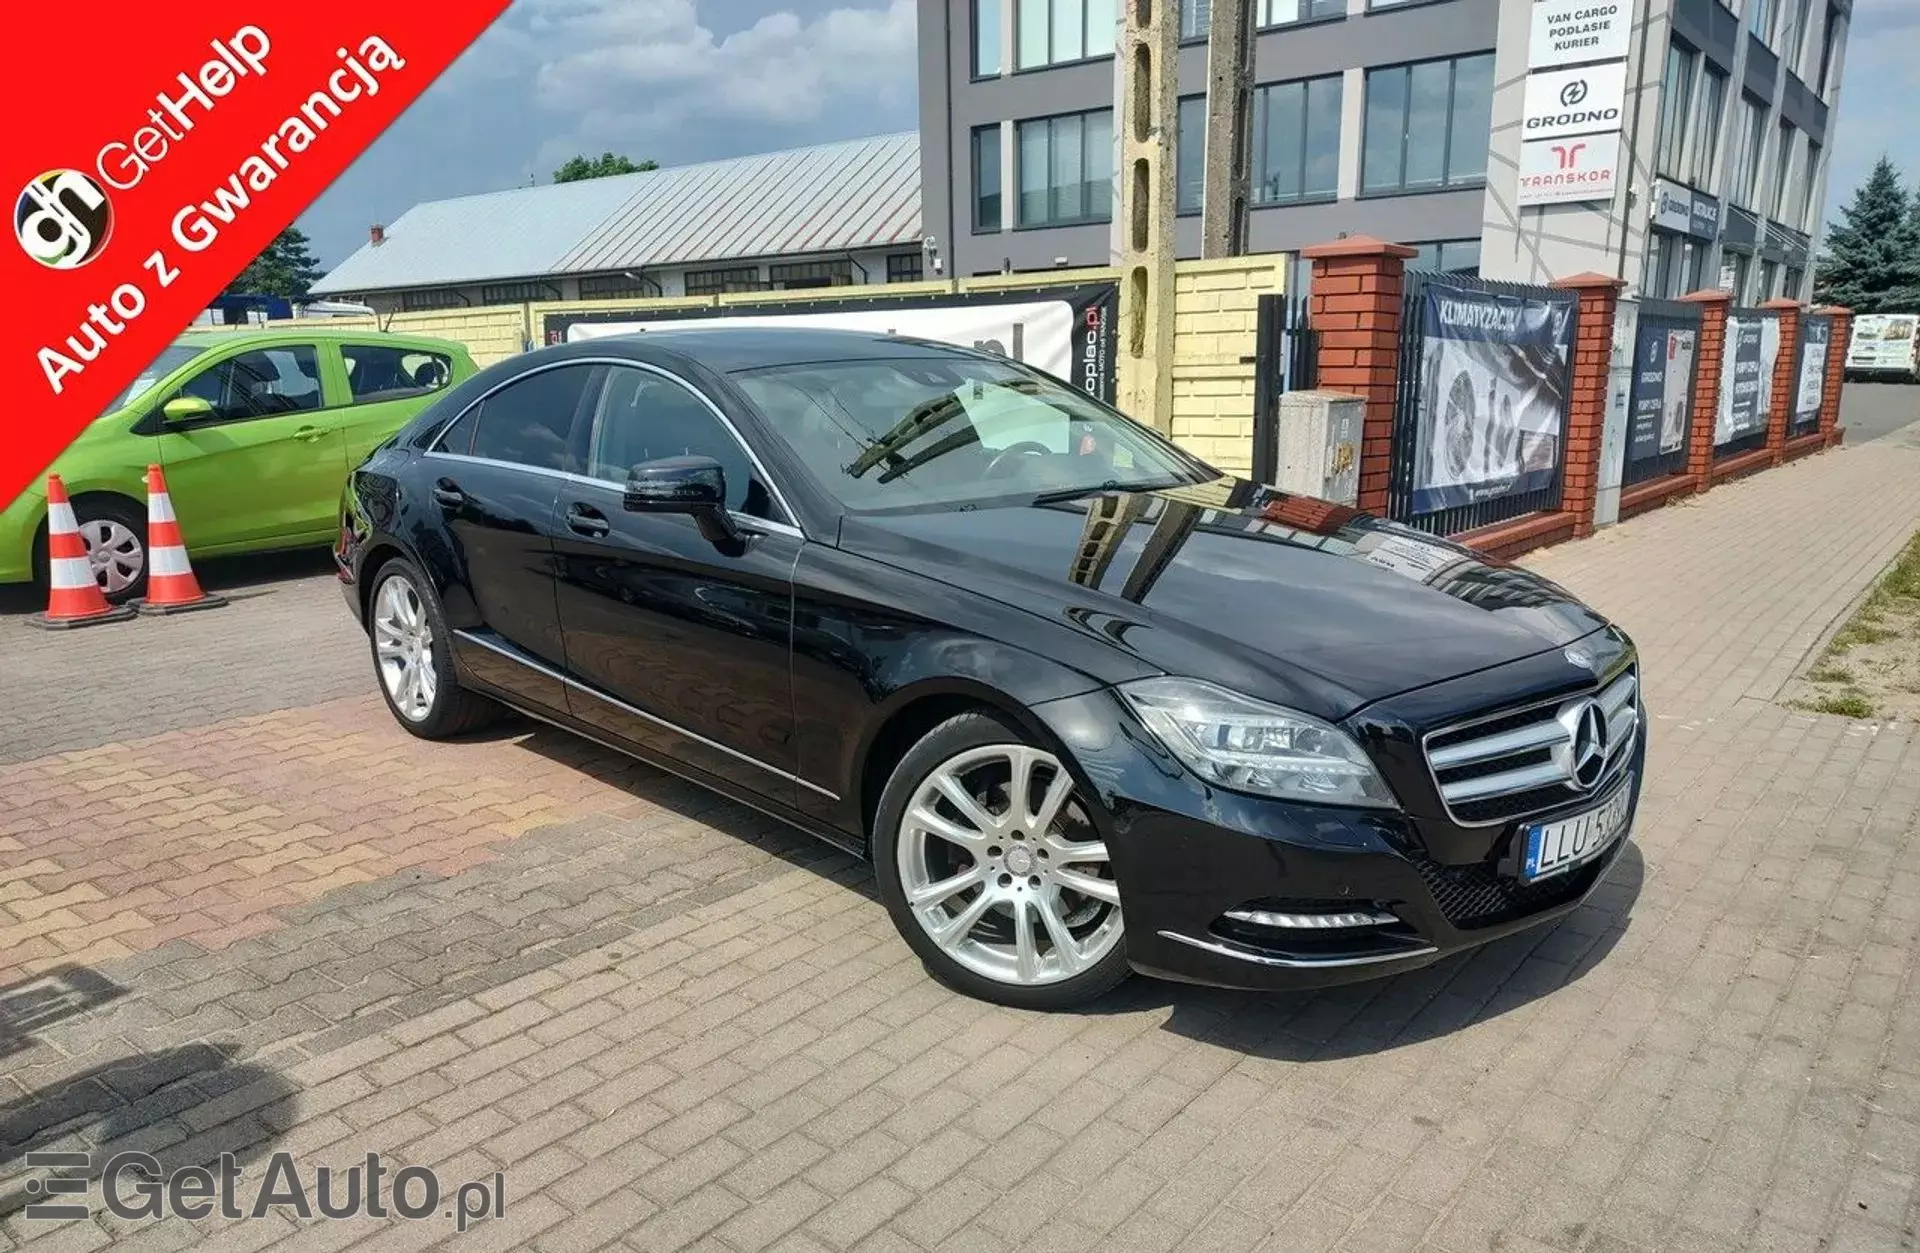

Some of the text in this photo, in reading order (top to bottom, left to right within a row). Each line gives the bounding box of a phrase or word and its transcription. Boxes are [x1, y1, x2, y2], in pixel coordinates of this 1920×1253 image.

[1547, 5, 1618, 24] VAN CARGO
[1549, 20, 1611, 37] PODLASIE
[1554, 36, 1599, 51] KURIER
[1526, 108, 1619, 129] GRODNO
[1520, 169, 1611, 188] TRANSKOR
[1083, 306, 1099, 396] oplac.pl
[1541, 816, 1591, 867] LLU
